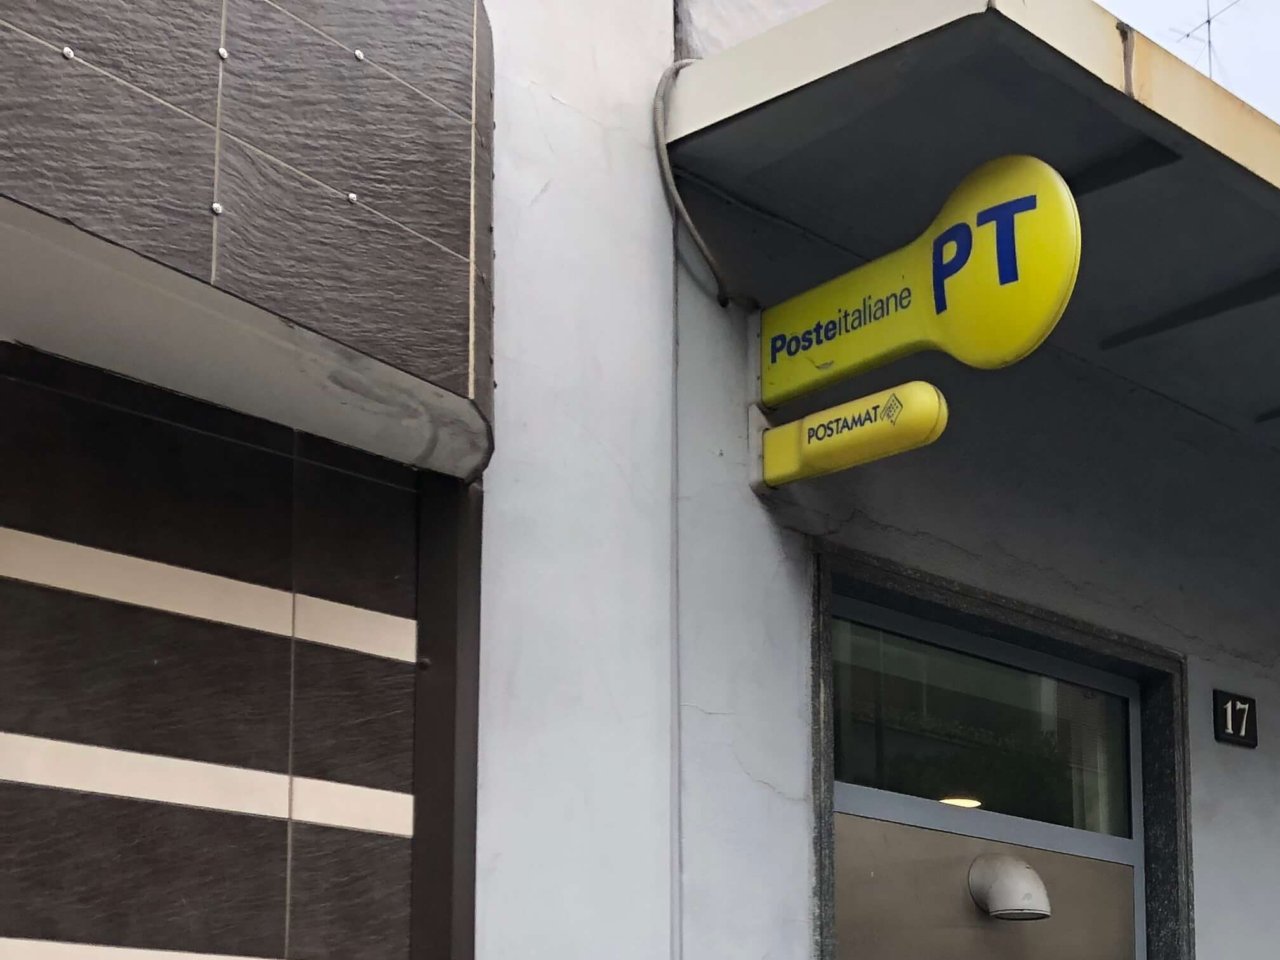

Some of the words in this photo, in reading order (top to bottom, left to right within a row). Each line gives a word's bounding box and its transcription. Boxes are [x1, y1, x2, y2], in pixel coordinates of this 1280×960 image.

[932, 194, 1037, 316] PT
[770, 286, 912, 365] Posteitaliane
[807, 404, 880, 445] POSTAMAT
[1223, 699, 1250, 737] 17
